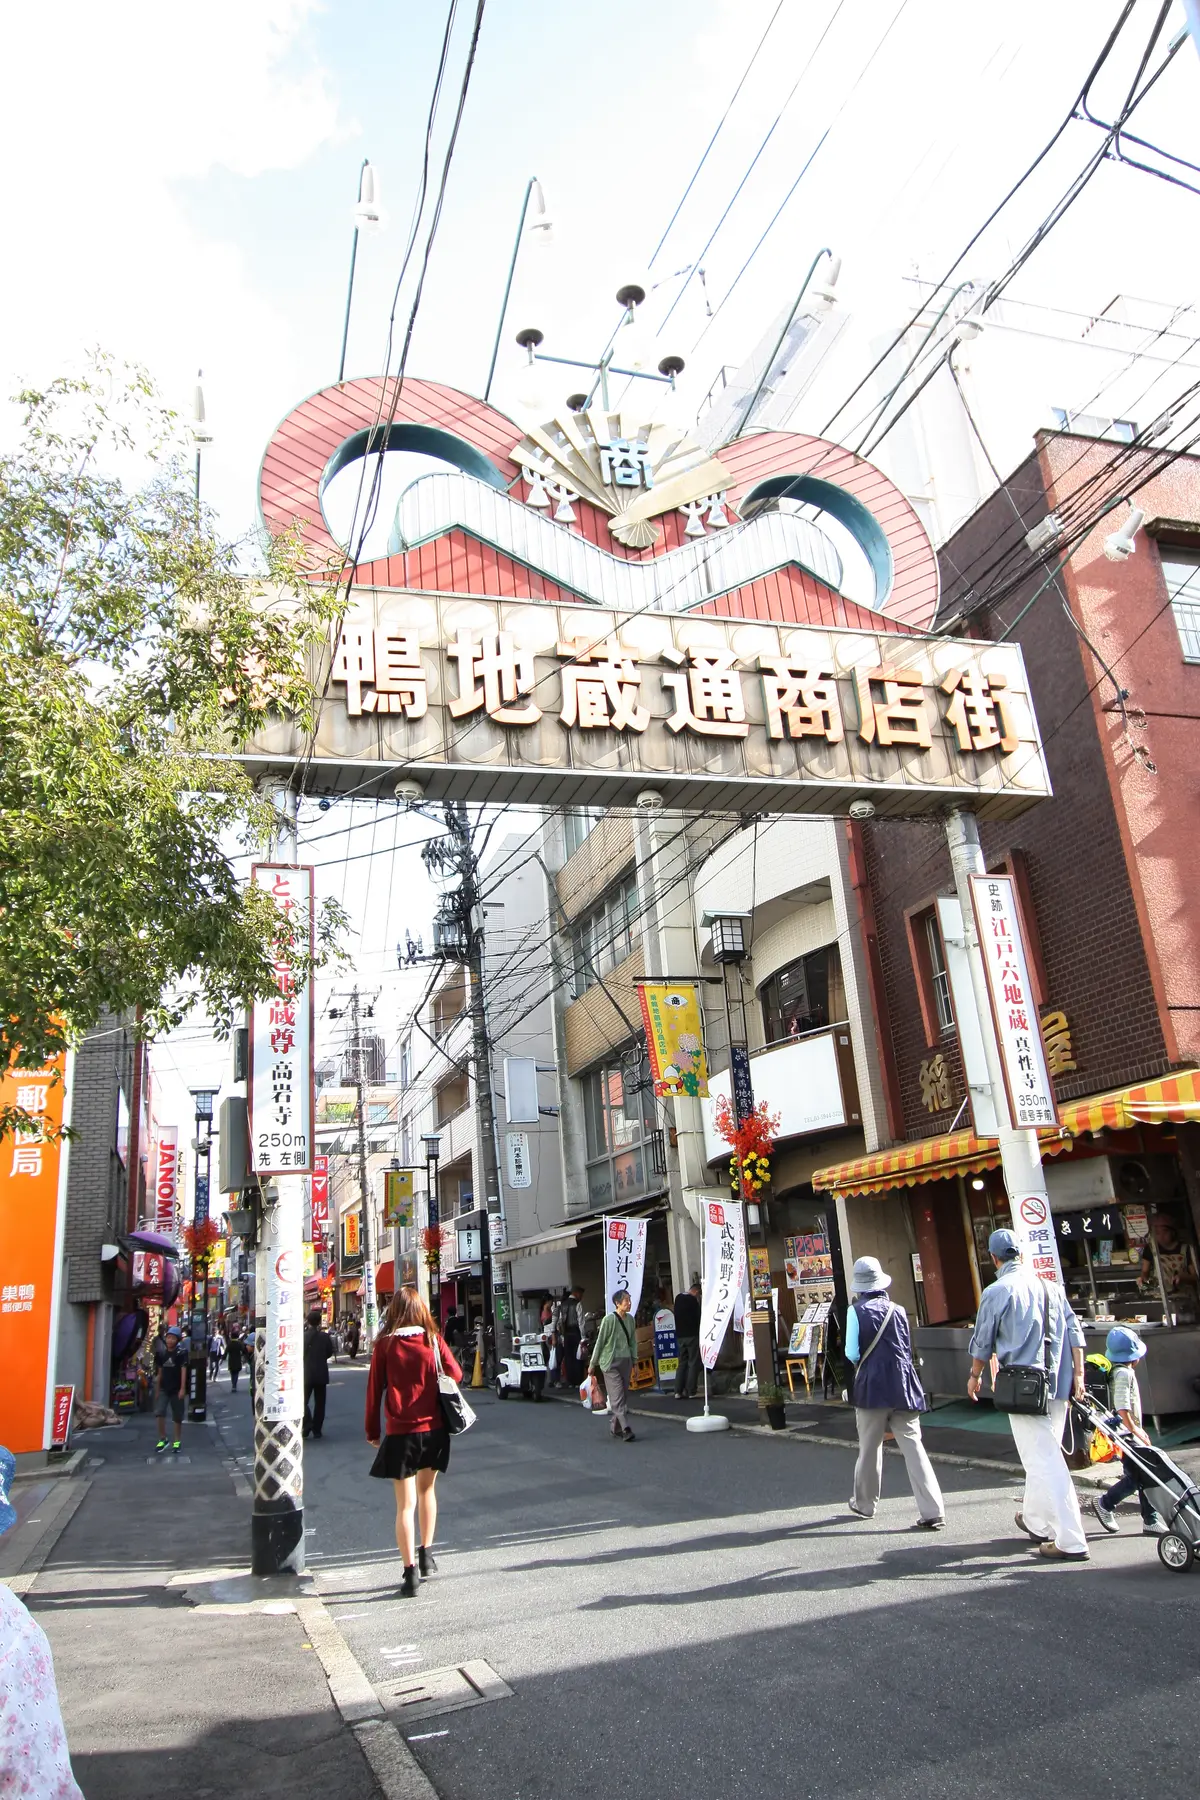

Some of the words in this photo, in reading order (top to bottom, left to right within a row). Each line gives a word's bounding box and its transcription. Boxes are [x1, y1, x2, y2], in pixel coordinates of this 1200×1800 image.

[600, 436, 653, 490] 商
[218, 626, 1019, 755] 鴨地蔵通商店街
[988, 883, 1003, 912] 史跡
[991, 916, 1029, 1031] 江戸六地蔵
[1015, 1037, 1037, 1089] 真性寺
[271, 1061, 293, 1126] 高岩寺
[1018, 1094, 1048, 1107] 350m
[1019, 1109, 1052, 1122] 信号手前
[258, 1133, 306, 1148] 250m
[258, 1152, 271, 1166] 先
[279, 1151, 306, 1166] 左側
[157, 1140, 175, 1233] JANOME
[1, 1284, 35, 1301] 巣鴨
[704, 1222, 735, 1342] 武蔵野うどん
